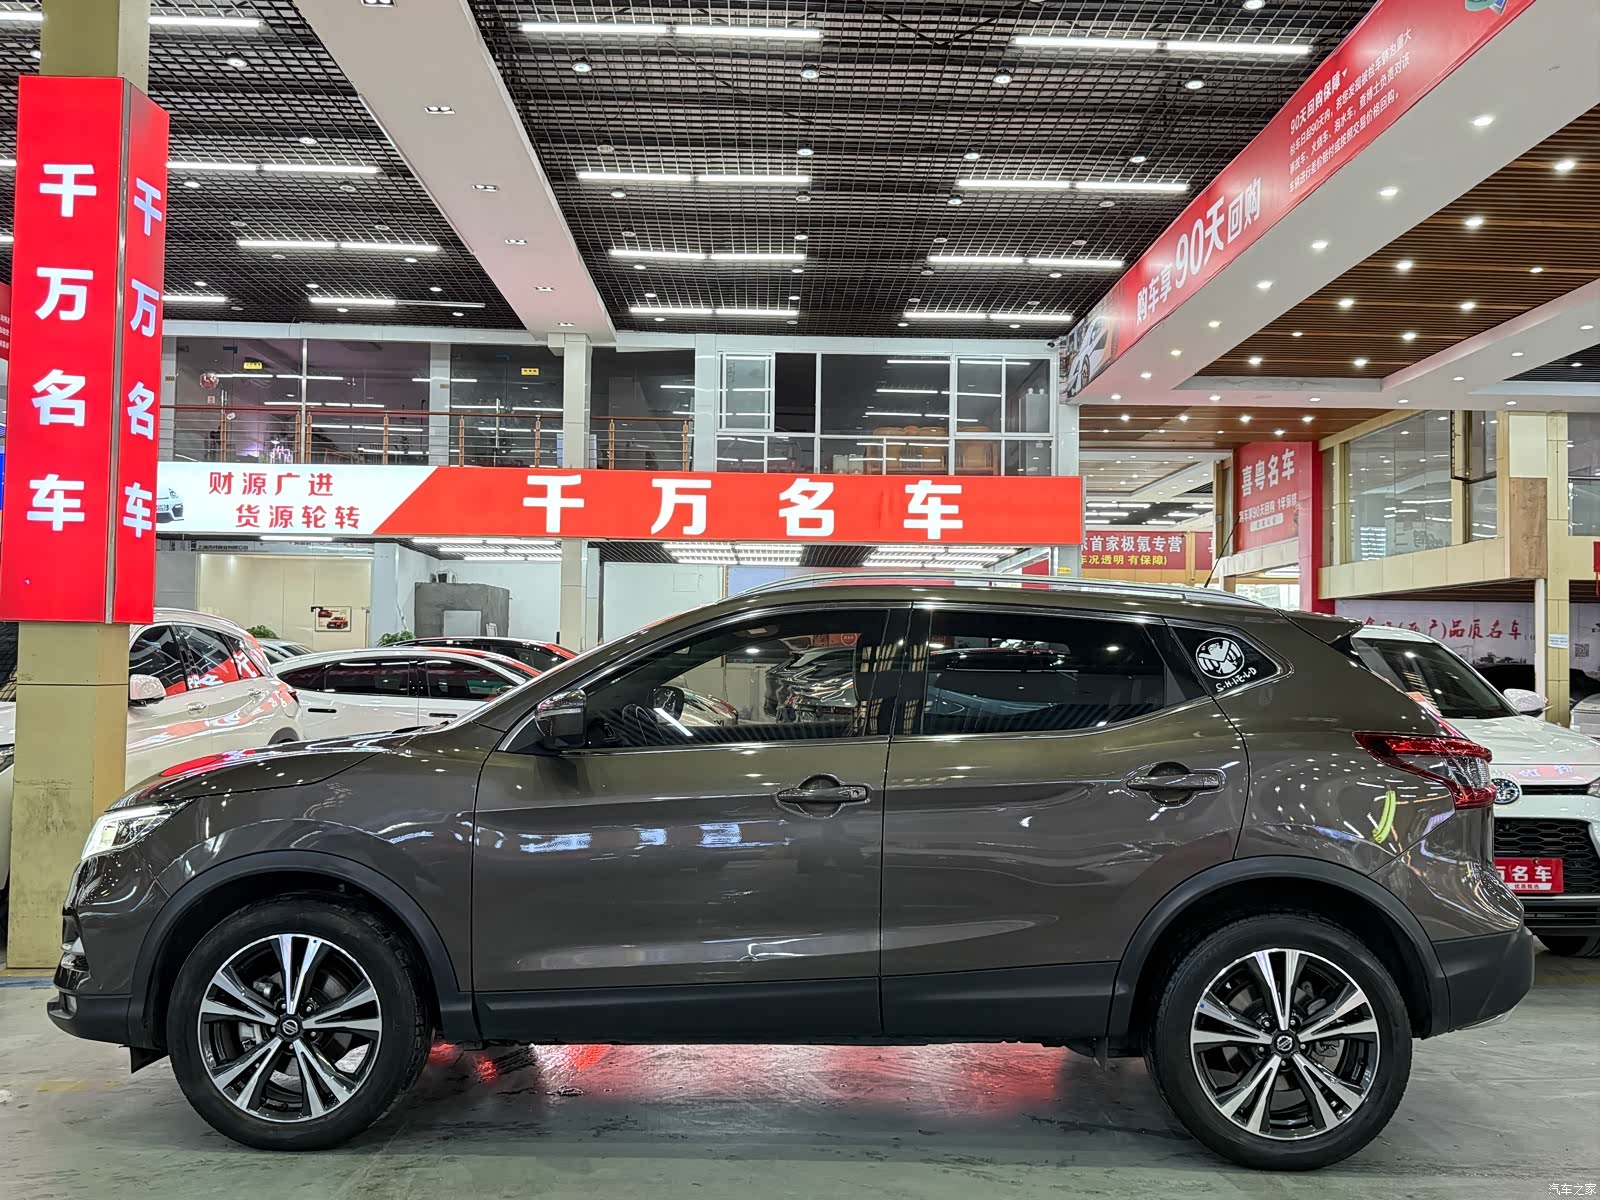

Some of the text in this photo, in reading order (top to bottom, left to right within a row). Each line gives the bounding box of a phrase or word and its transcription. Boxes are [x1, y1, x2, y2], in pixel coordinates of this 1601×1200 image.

[26, 163, 97, 532] 千万名车
[122, 177, 163, 538] 千万名车
[209, 471, 333, 497] 财源广进
[1242, 448, 1295, 497] 喜粤名车
[235, 504, 361, 529] 货源轮转
[523, 474, 963, 540] 千万名车
